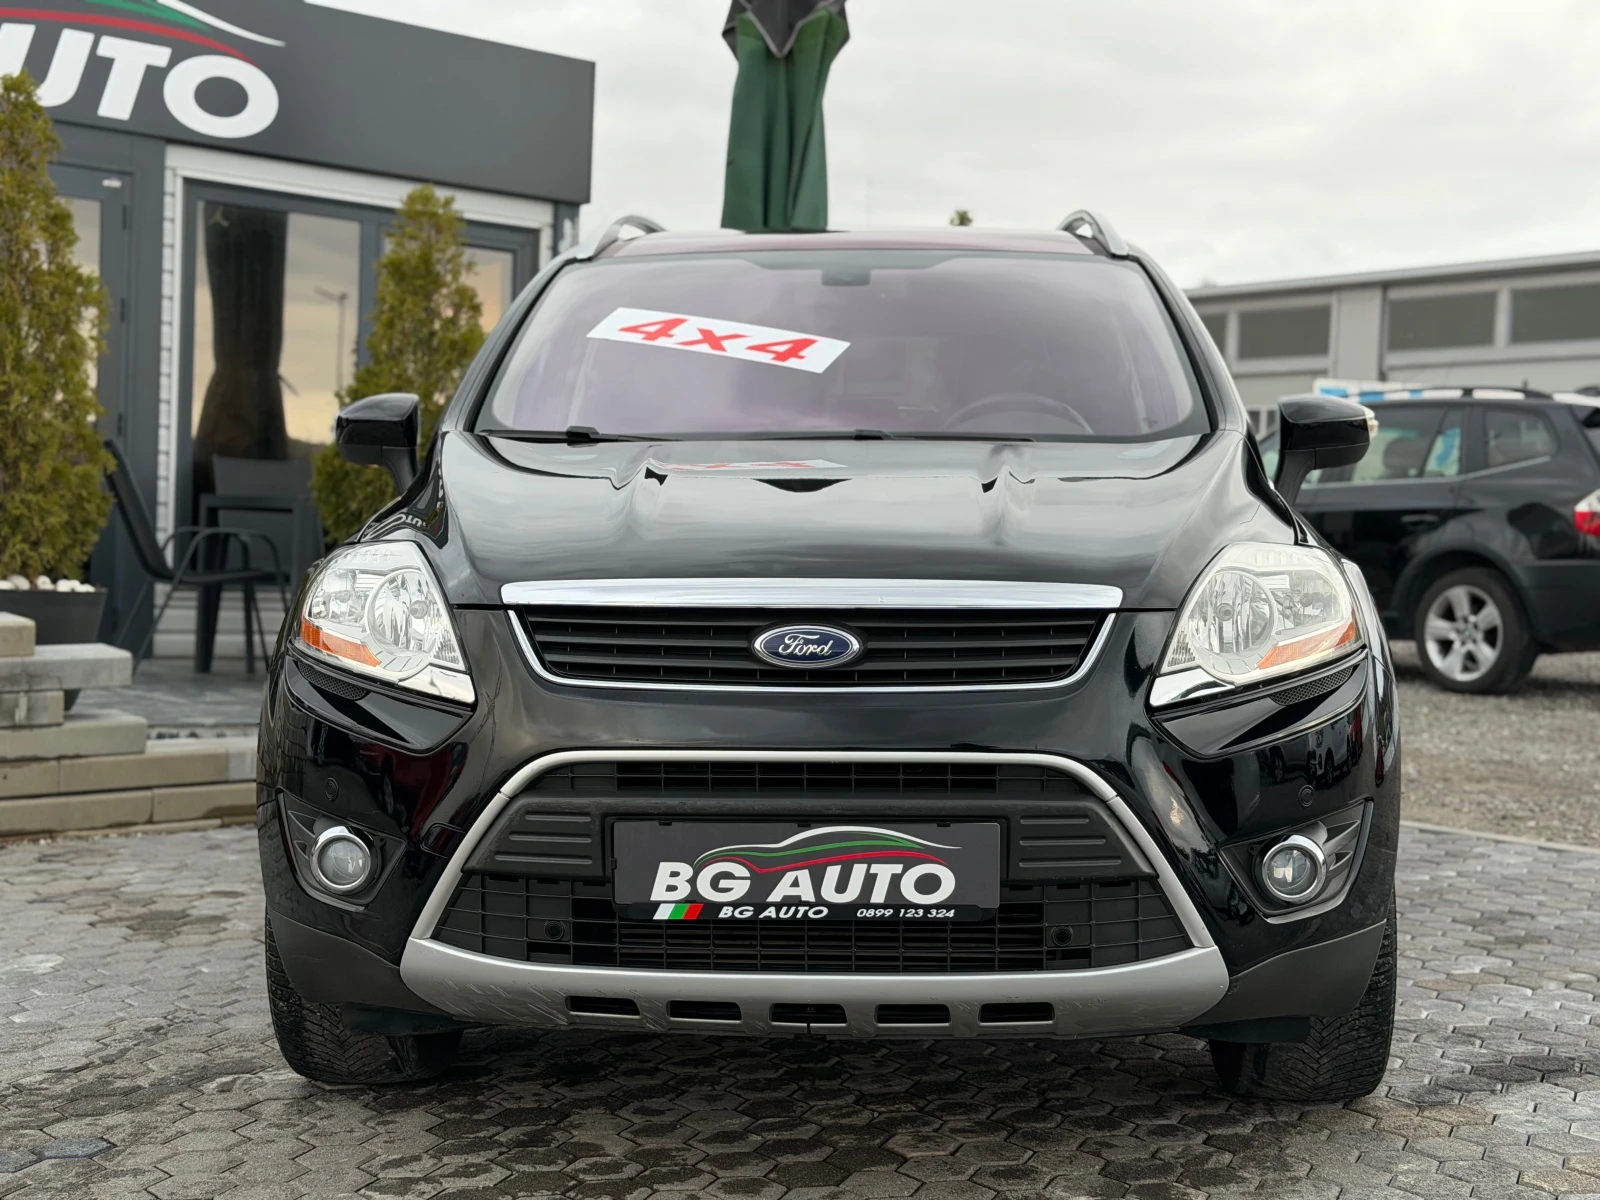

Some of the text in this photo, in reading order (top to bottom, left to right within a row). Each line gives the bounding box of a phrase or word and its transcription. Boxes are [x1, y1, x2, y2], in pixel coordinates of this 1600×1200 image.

[0, 23, 279, 138] UTO
[617, 317, 819, 363] 4x4
[778, 633, 833, 656] Ford
[649, 861, 956, 905] BG AUTO
[718, 906, 955, 919] BG AUTO 0899 123 324
